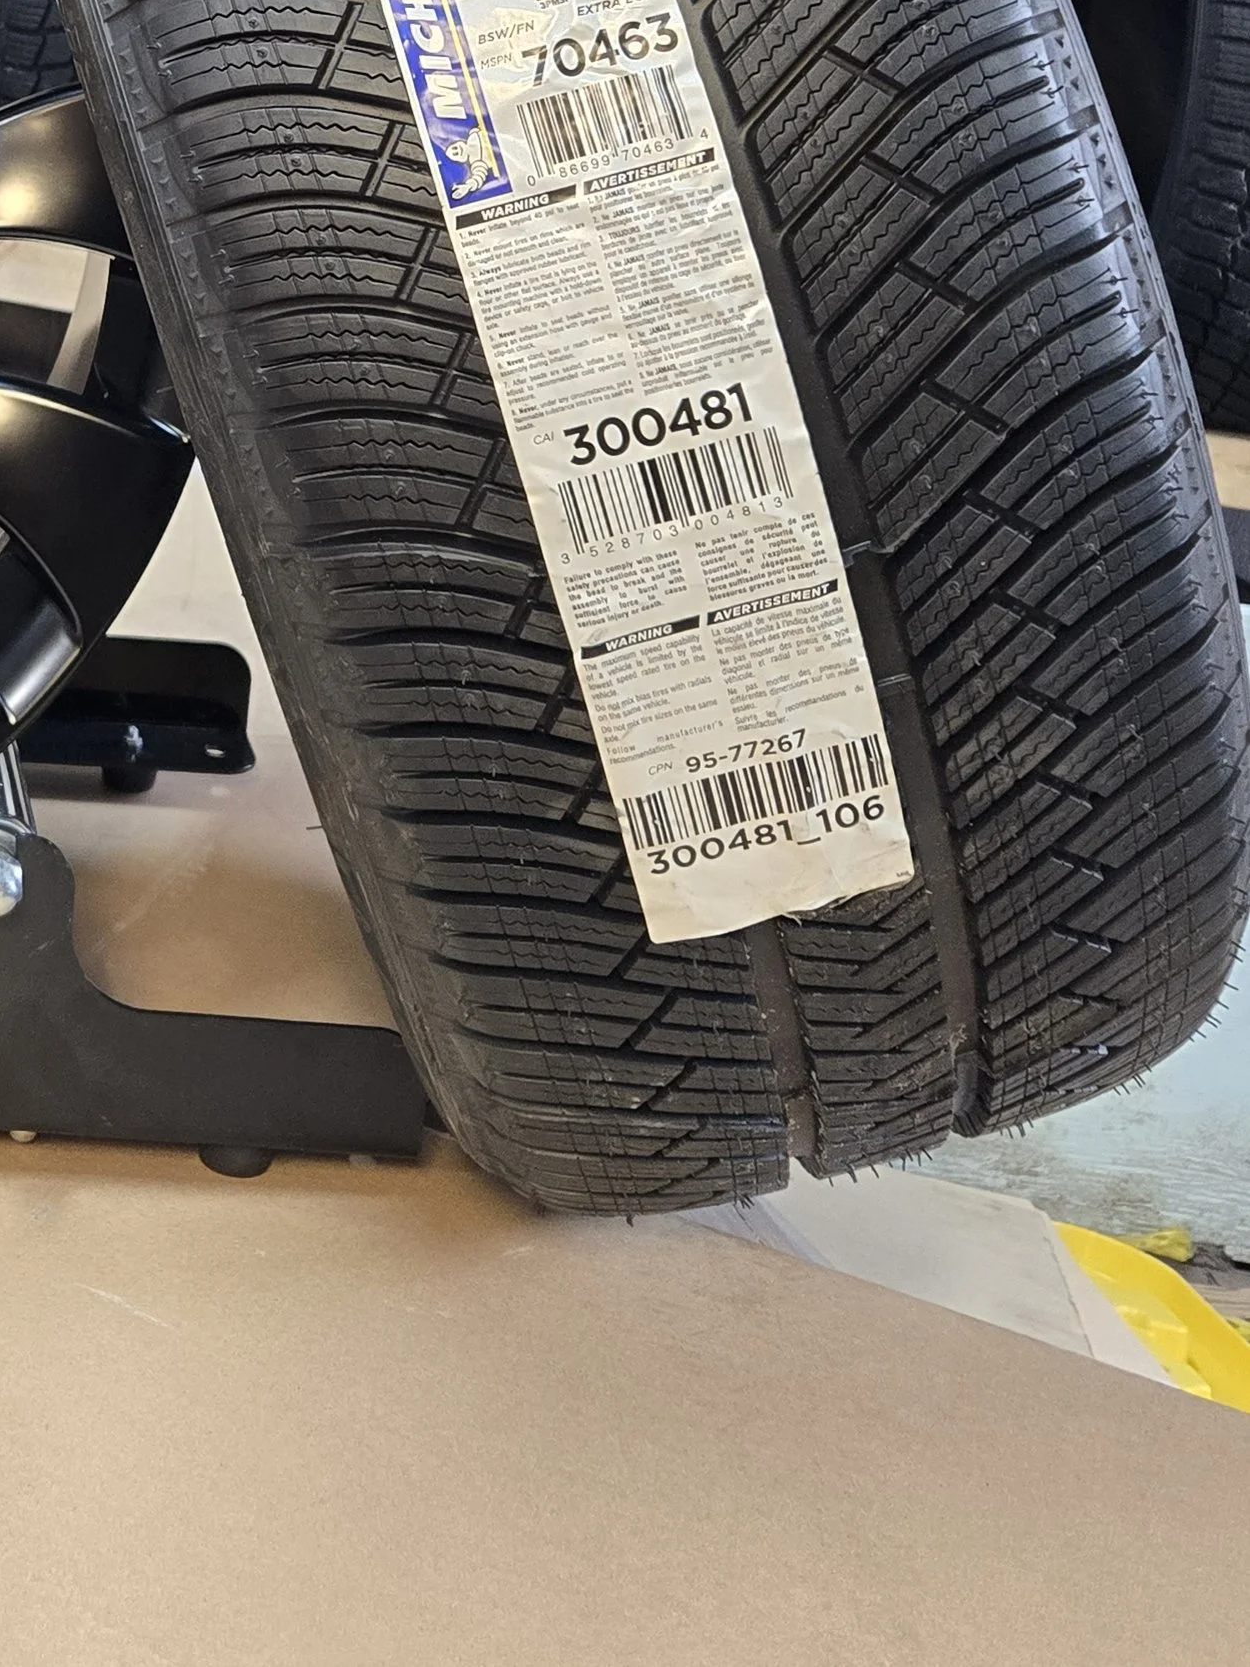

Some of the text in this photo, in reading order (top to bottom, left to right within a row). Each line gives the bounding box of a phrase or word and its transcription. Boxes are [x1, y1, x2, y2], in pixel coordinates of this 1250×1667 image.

[475, 19, 537, 46] BSW/FN
[478, 10, 681, 88] MSPN 70463
[526, 173, 537, 188] 0
[587, 150, 707, 193] AVERTISSEMENT
[480, 192, 551, 221] WARNING
[563, 382, 752, 465] 300481
[713, 583, 831, 623] AVERTISSEMENT
[605, 623, 673, 652] WARNING
[647, 728, 807, 777] CPN 95-77267
[647, 795, 885, 875] 300481_106
